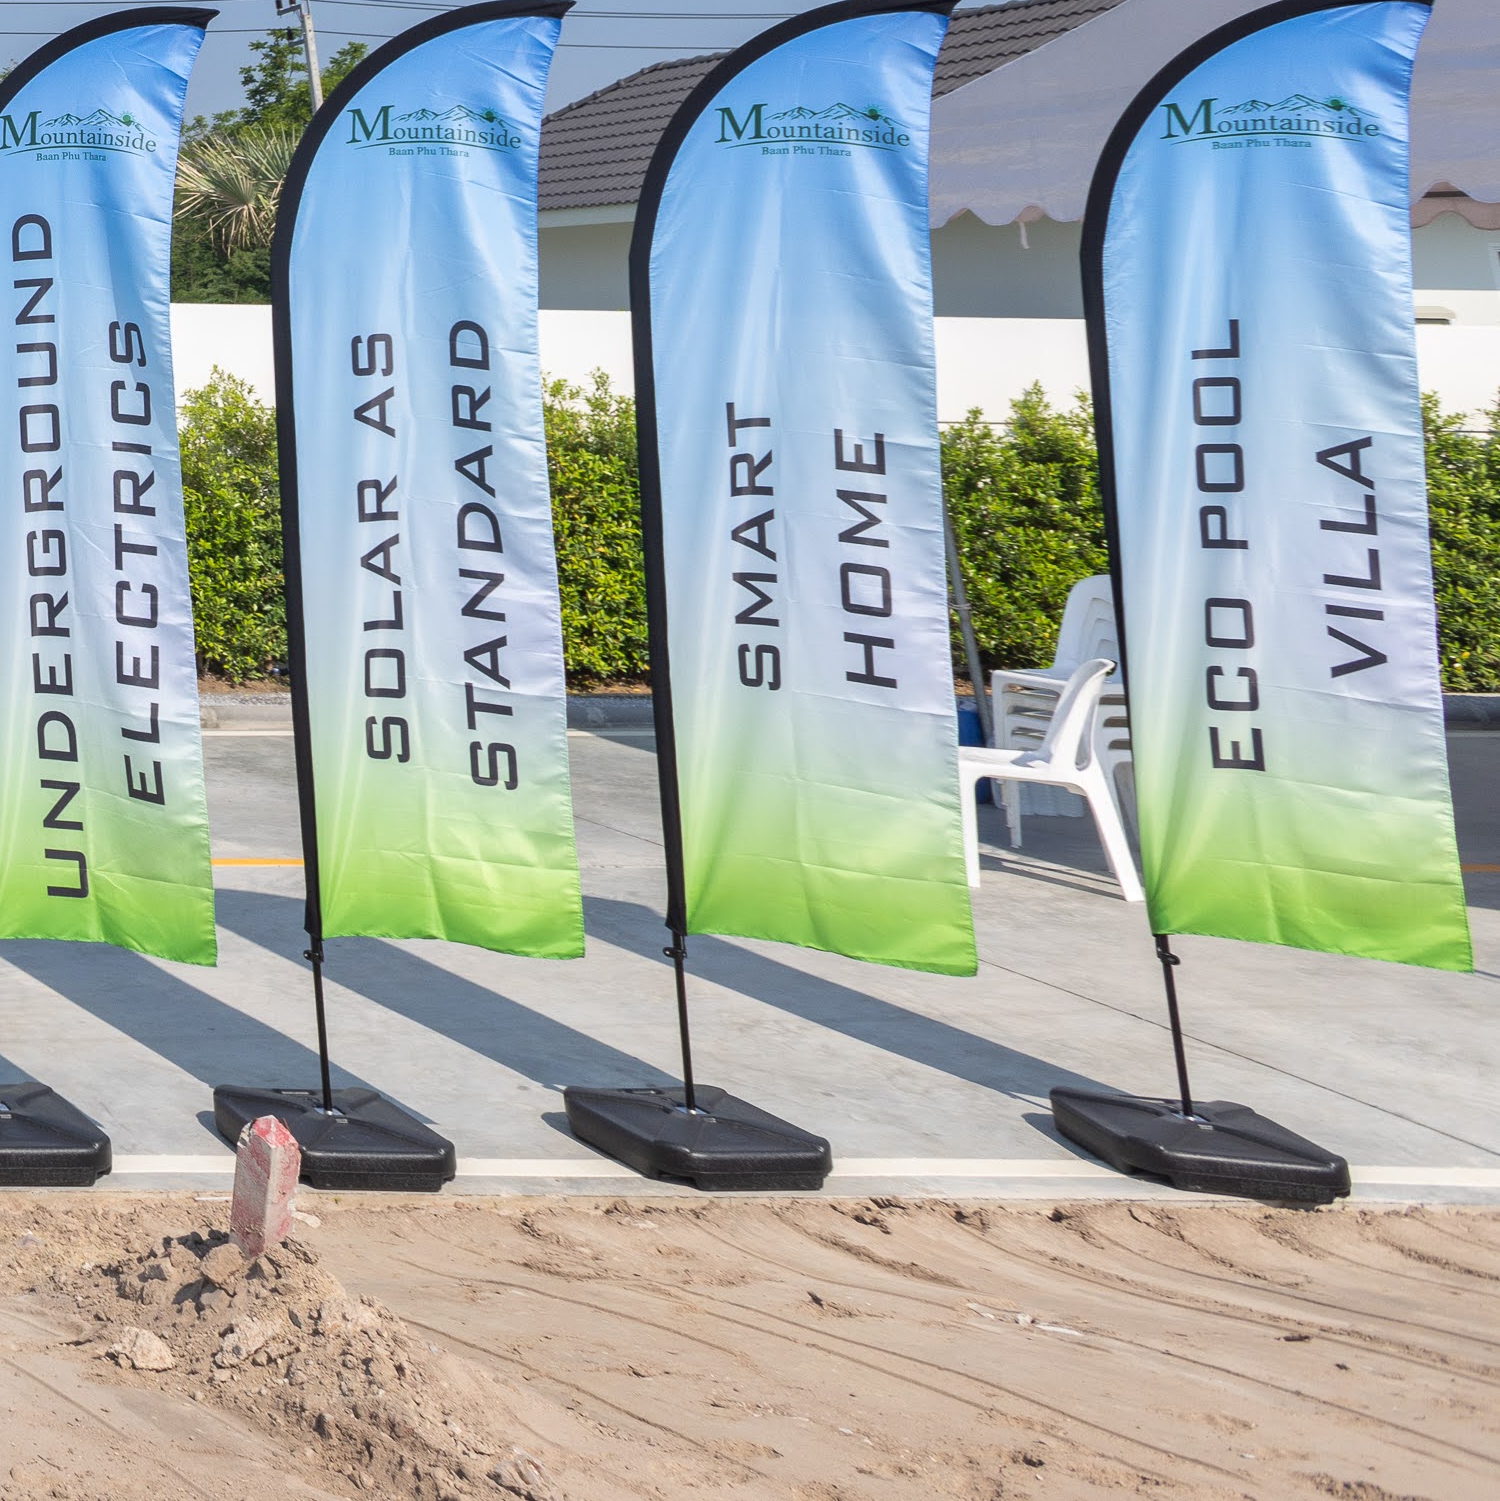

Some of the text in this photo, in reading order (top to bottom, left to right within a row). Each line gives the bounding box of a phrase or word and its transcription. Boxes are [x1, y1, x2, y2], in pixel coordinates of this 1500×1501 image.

[36, 152, 107, 162] Baan Phu Thara
[346, 105, 522, 149] Mountainside
[388, 146, 470, 158] Baan Phu Thara
[714, 103, 910, 146] Mountainside
[761, 145, 852, 157] Baan Phu Thara
[1160, 98, 1379, 139] Mountainside
[1211, 138, 1312, 150] Baan Phu Thara
[12, 213, 89, 899] UNDERGROUND
[109, 320, 166, 806] ELECTRICS
[351, 332, 411, 763] SOLAR AS
[448, 319, 518, 791] STANDARD
[726, 401, 782, 691] SMART
[833, 427, 898, 689] HOME
[1191, 318, 1266, 772] ECO POOL
[1316, 435, 1388, 678] VILLA
